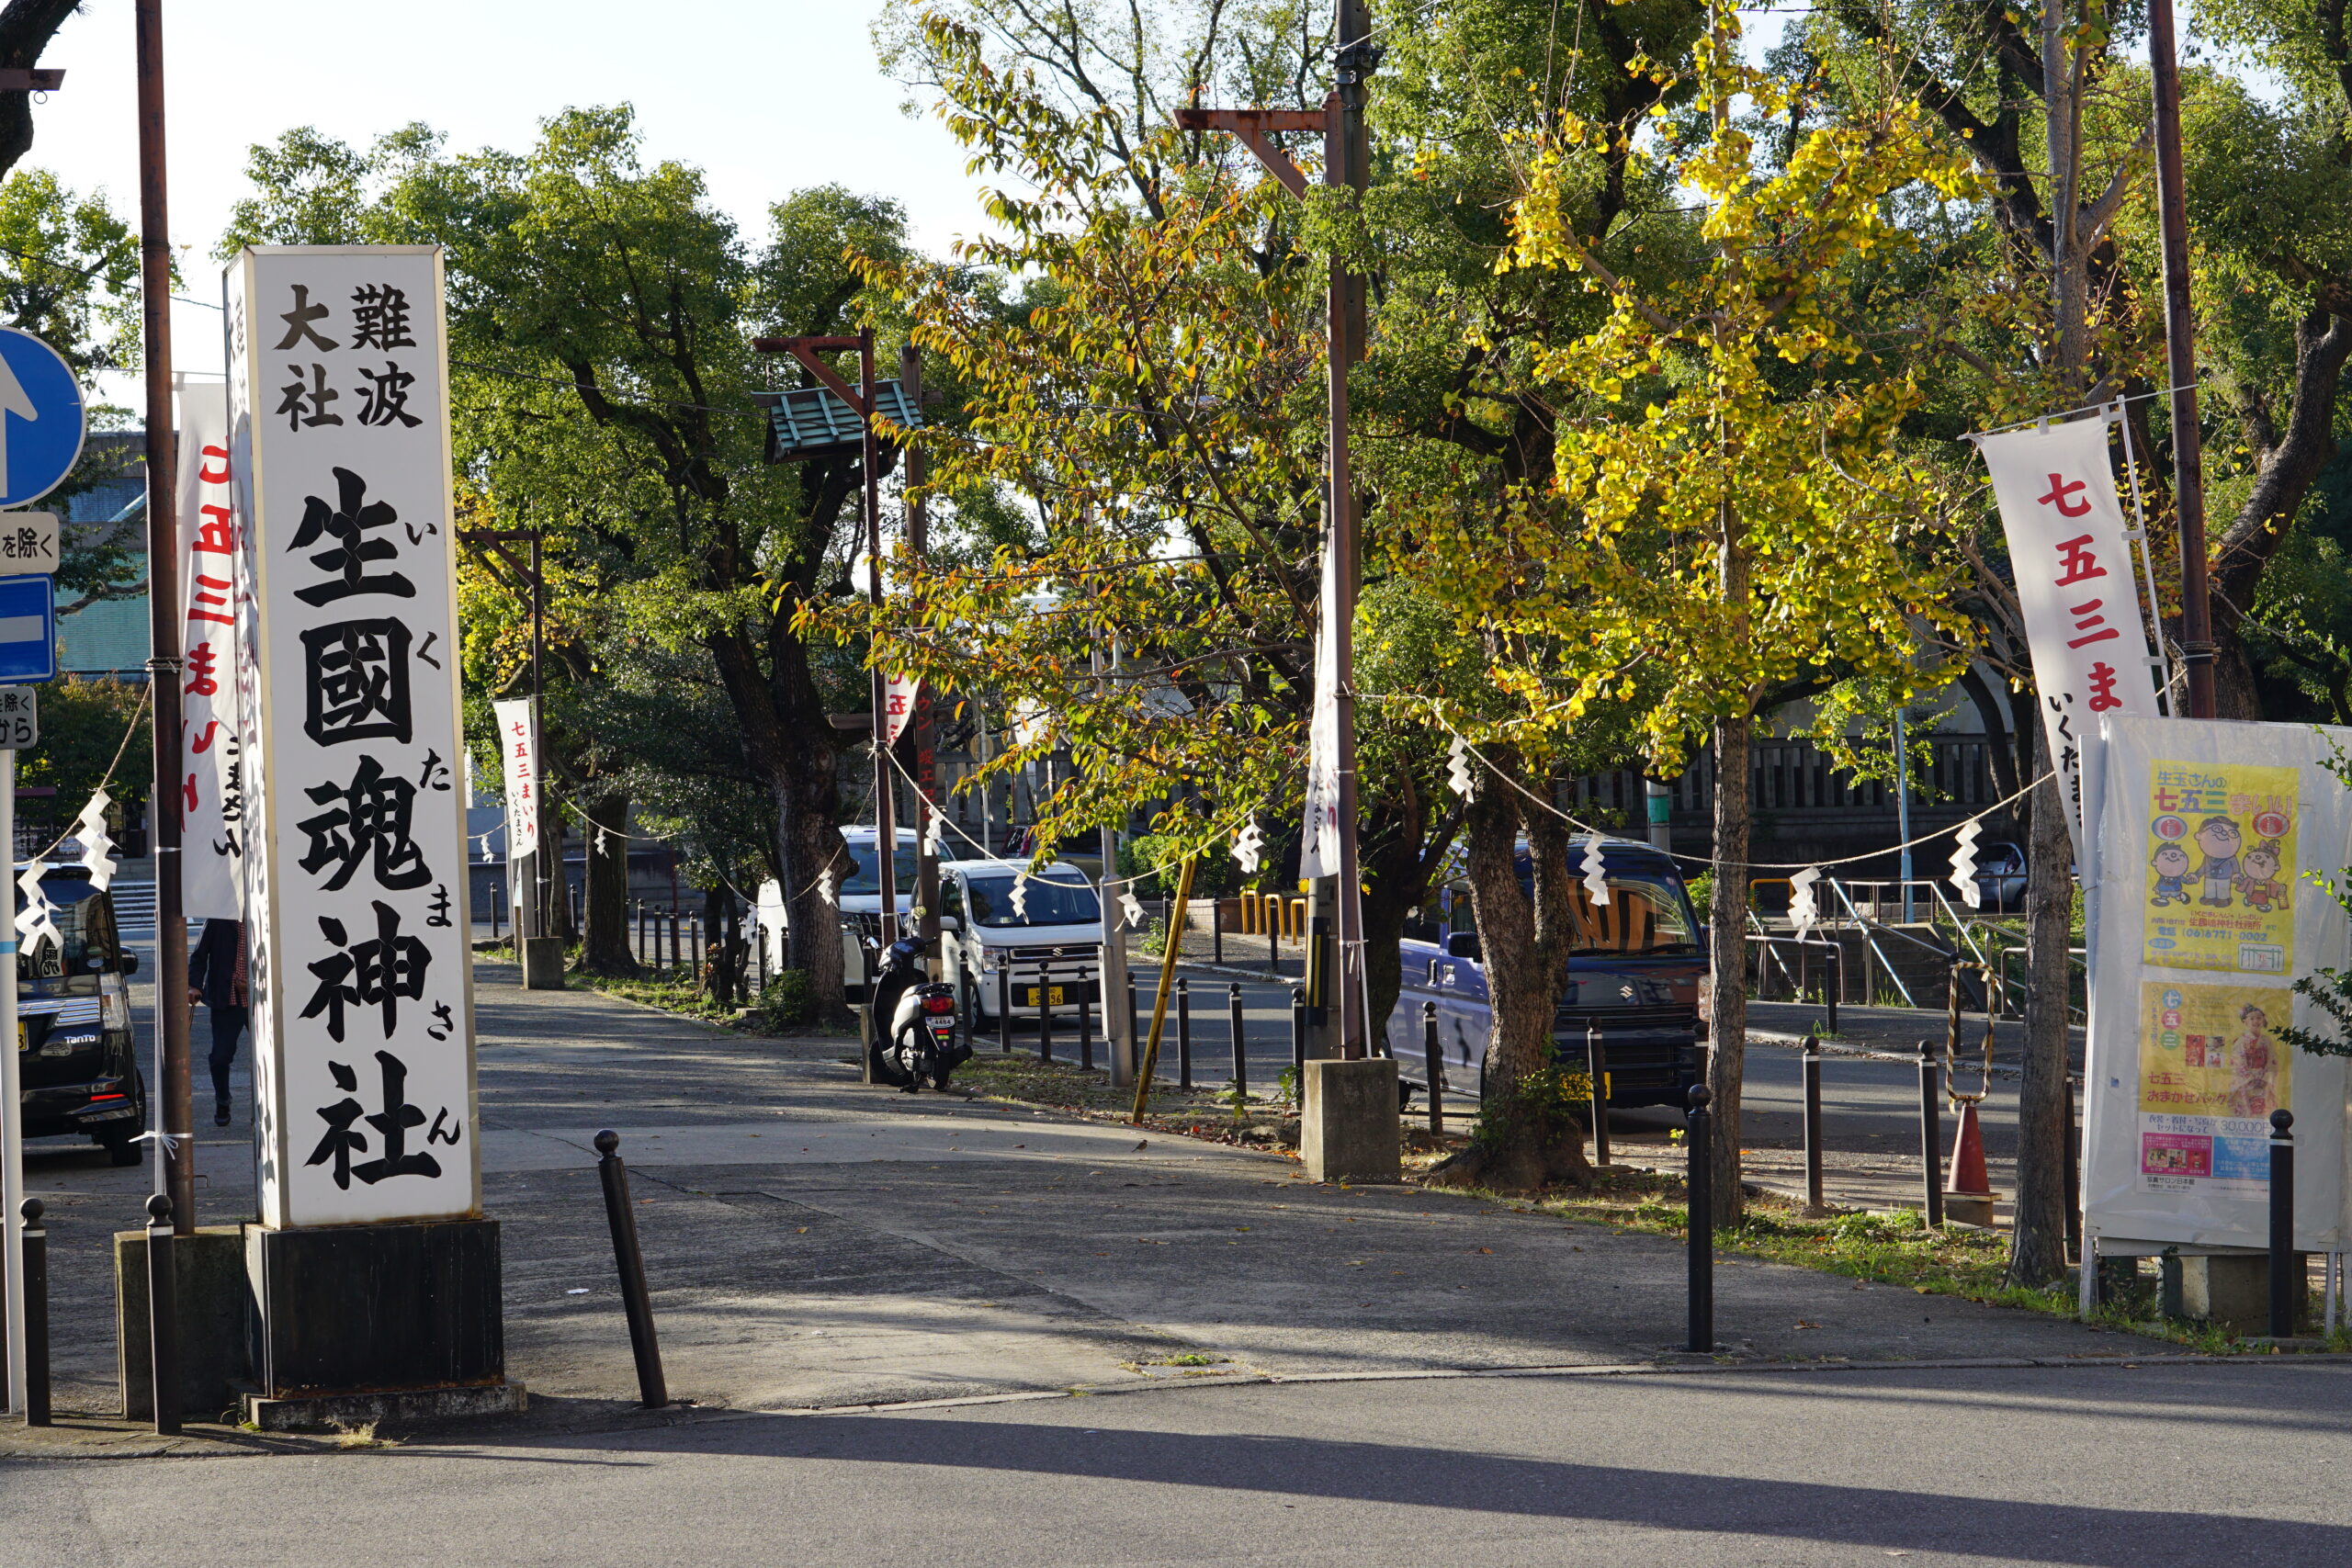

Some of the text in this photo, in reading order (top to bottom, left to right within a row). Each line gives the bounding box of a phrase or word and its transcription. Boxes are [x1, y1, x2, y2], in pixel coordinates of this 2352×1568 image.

[273, 284, 345, 433] 大社
[351, 283, 424, 429] 難波
[2037, 472, 2123, 713] 七五三ま
[286, 466, 441, 1190] 生國魂神社
[404, 522, 461, 1145] いくたまさん
[511, 721, 536, 840] 七五三まいり
[511, 789, 524, 847] いくたまさん
[2154, 787, 2292, 817] 七五三まいり
[2156, 771, 2227, 789] 生玉さんの
